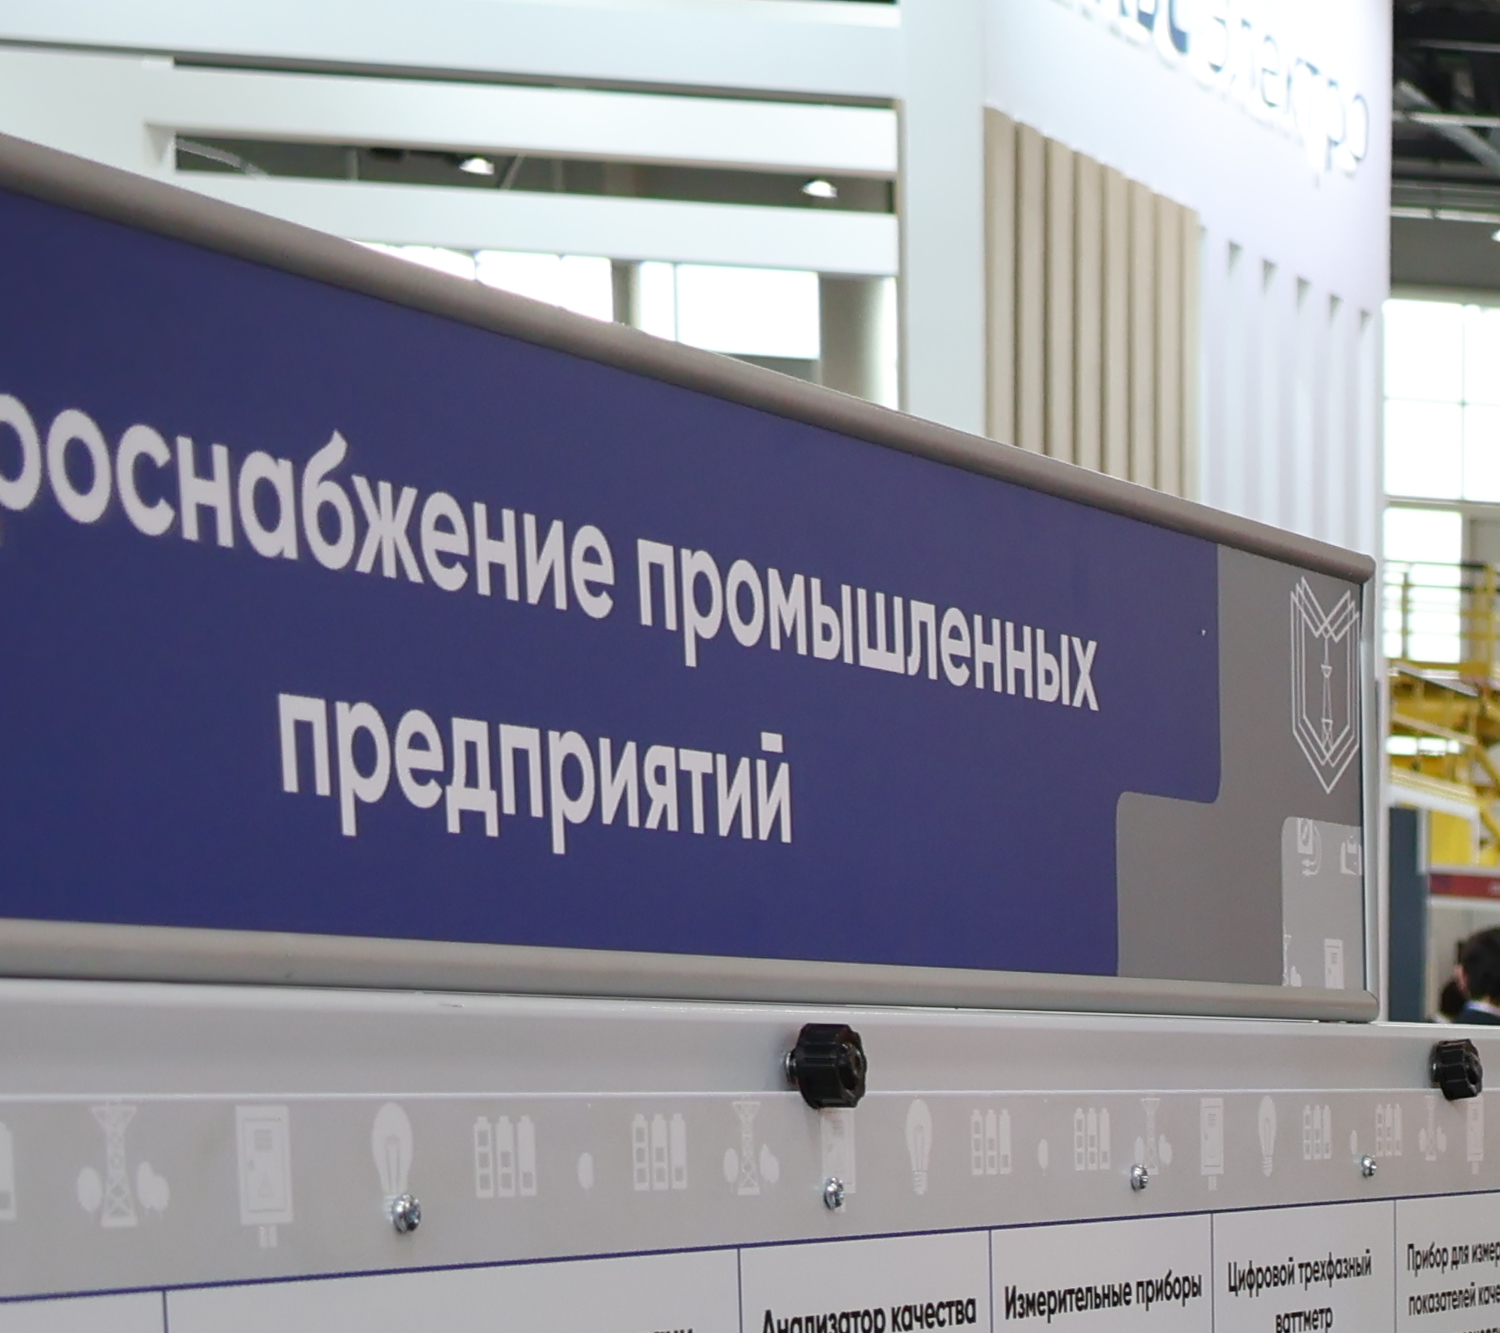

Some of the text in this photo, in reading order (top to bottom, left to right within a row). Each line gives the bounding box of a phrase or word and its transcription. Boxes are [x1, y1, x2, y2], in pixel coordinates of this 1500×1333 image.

[636, 537, 1099, 713] промышленных
[278, 691, 792, 853] предприятий
[1228, 1248, 1372, 1299] Цифровой трехфазный
[1406, 1240, 1450, 1277] Прибор
[1450, 1246, 1470, 1269] для
[1004, 1269, 1202, 1324] Измерительные приборы
[1408, 1283, 1476, 1317] показателей
